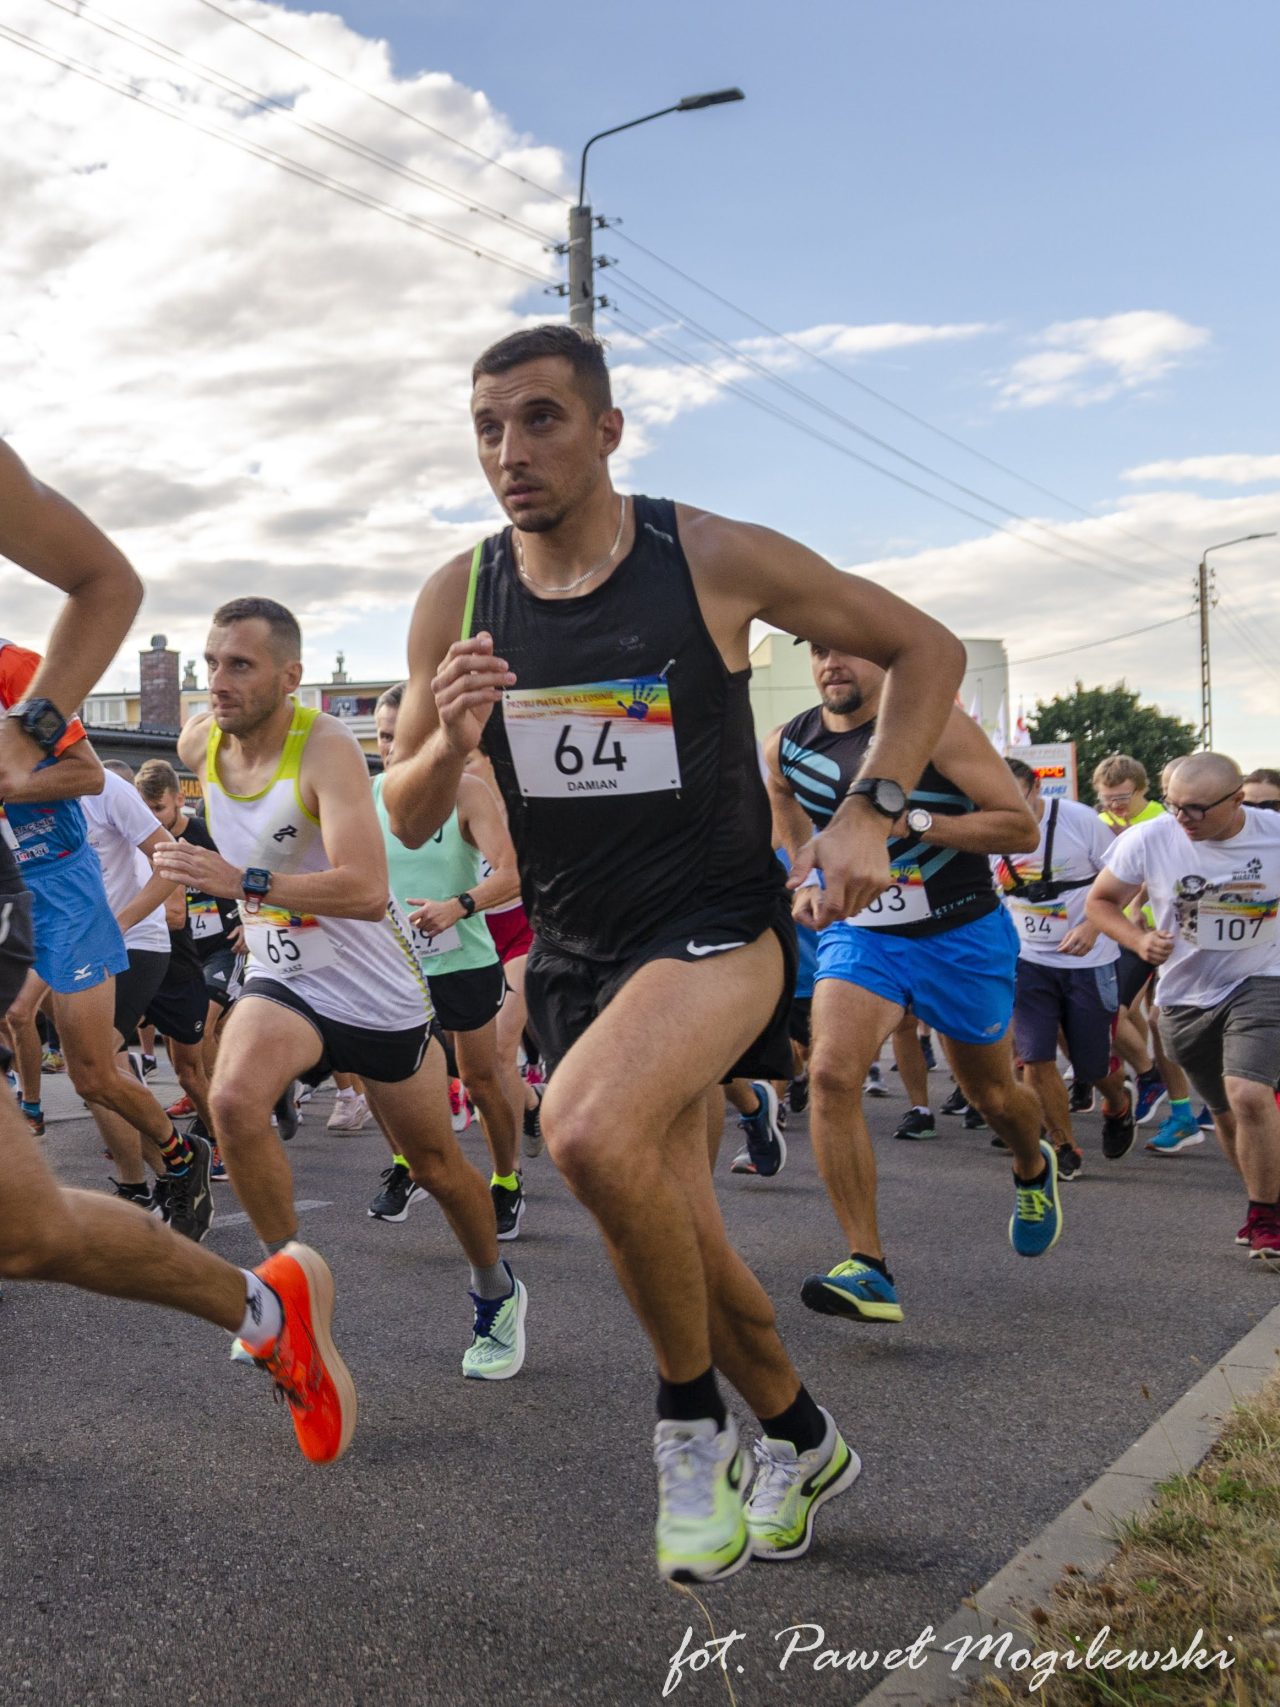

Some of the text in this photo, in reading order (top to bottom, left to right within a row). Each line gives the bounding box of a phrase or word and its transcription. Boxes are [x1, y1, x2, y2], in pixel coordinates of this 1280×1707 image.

[555, 720, 627, 776] 64
[567, 780, 617, 791] DAMIAN
[1024, 916, 1051, 934] 84
[1215, 918, 1265, 941] 107
[267, 929, 300, 964] 65
